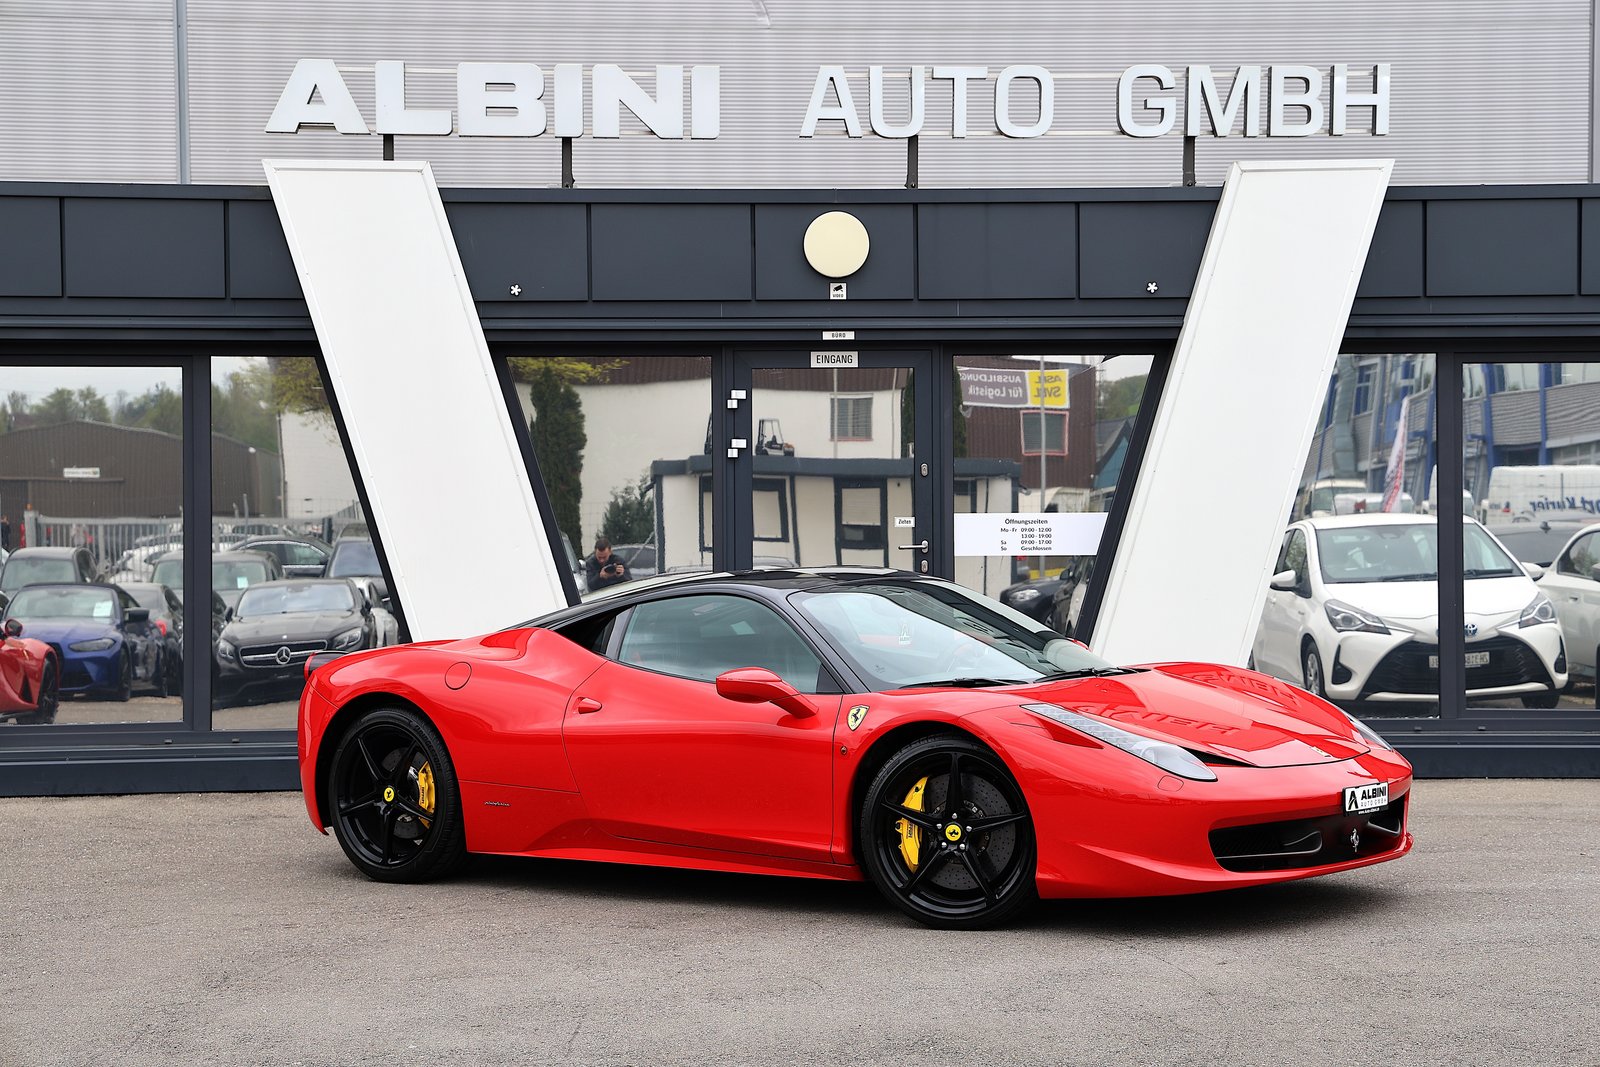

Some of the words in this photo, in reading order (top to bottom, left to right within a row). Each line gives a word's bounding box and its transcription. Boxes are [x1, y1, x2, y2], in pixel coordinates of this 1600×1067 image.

[264, 58, 720, 140] ALBINI
[799, 64, 1055, 139] AUTO
[1116, 63, 1391, 138] GMBH
[816, 354, 853, 364] EINGANG
[1361, 786, 1386, 800] ALBINI
